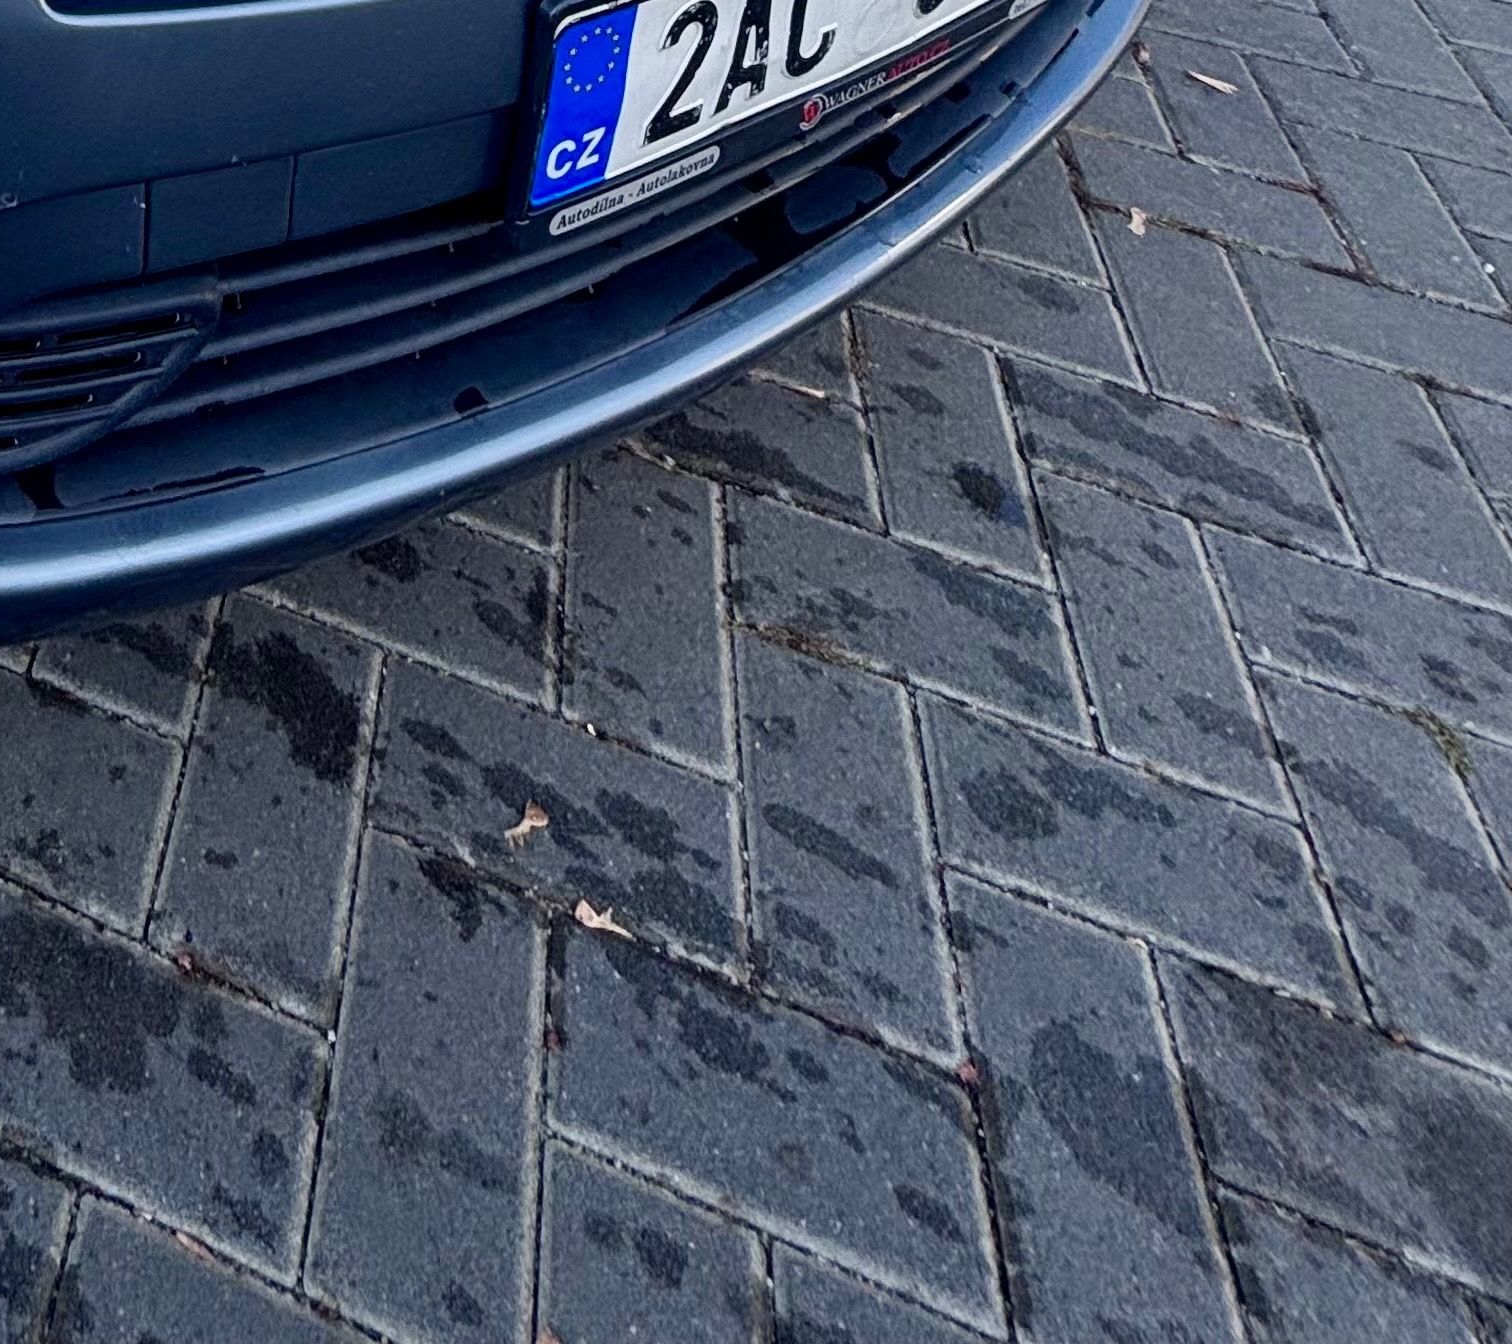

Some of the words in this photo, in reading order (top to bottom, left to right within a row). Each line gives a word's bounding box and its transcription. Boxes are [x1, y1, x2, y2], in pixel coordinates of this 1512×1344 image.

[546, 127, 607, 179] CZ
[555, 193, 624, 230] Autodílna
[636, 153, 716, 197] Autolakovna
